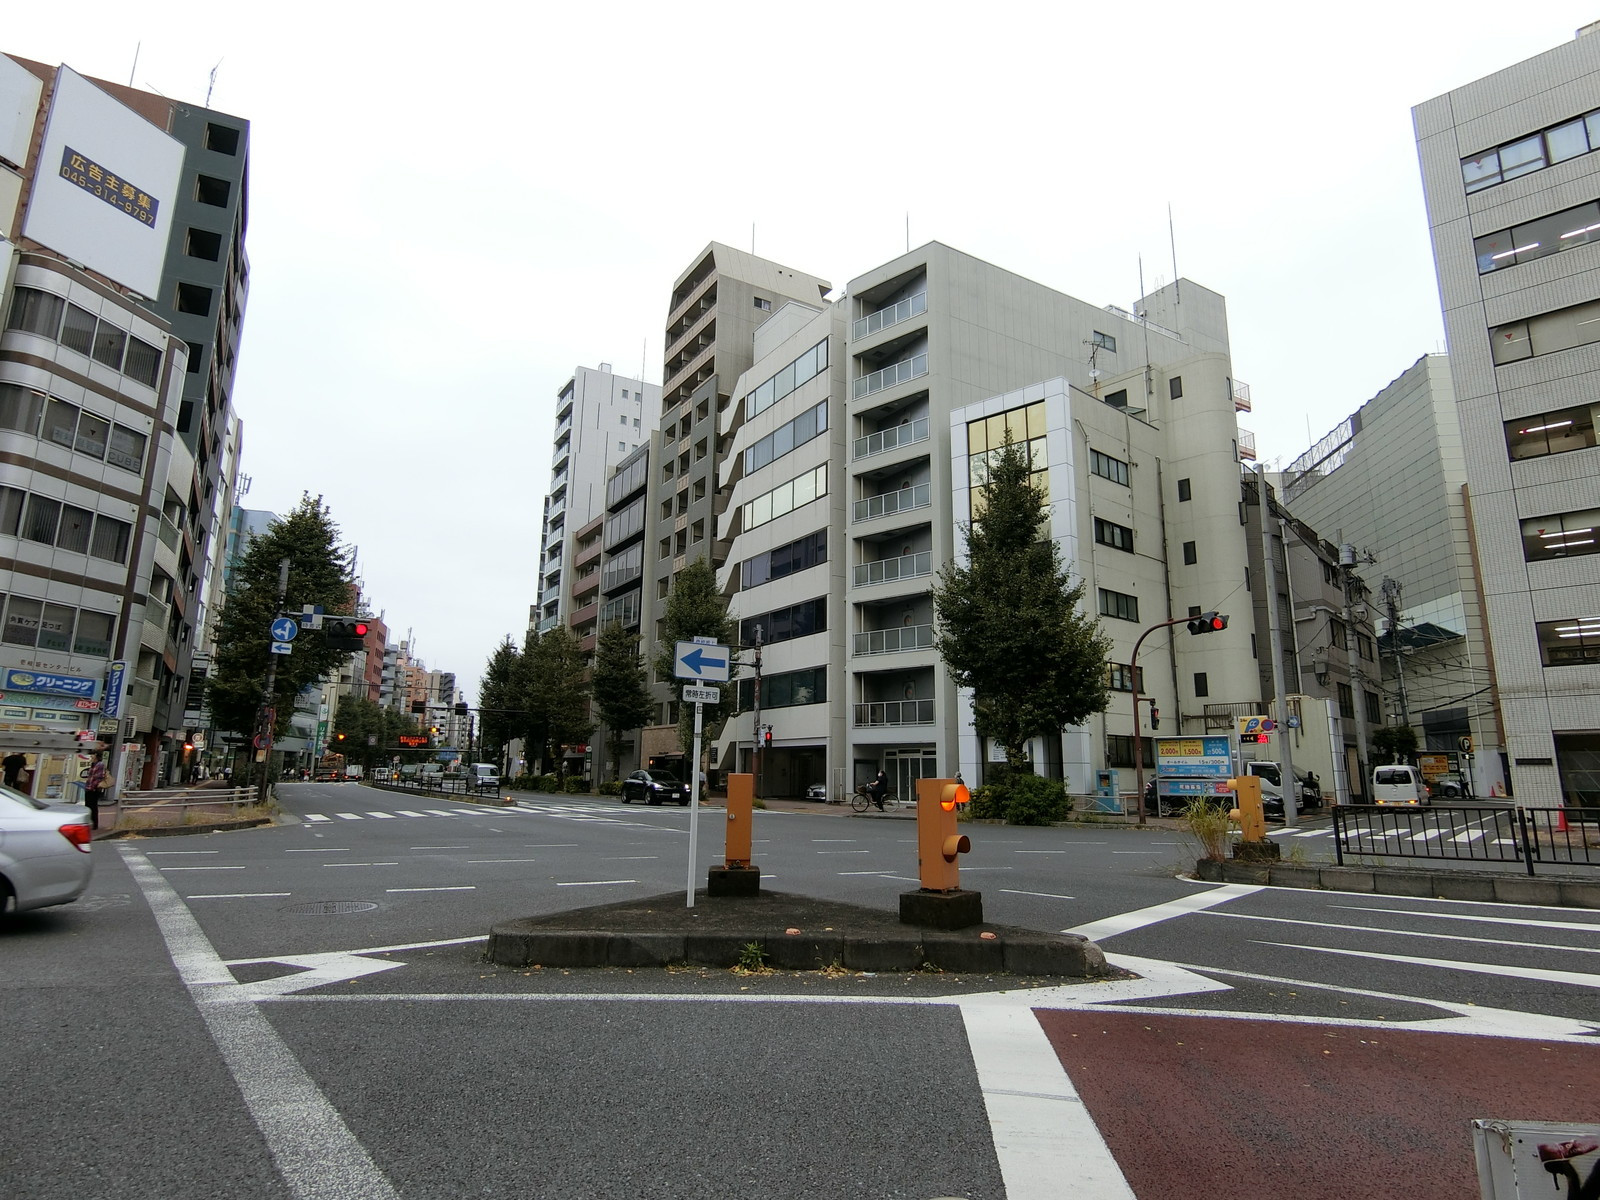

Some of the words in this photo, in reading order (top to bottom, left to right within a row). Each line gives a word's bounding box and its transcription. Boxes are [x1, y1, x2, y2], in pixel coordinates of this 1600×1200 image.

[61, 165, 155, 225] 045-314-9797
[70, 153, 153, 211] 広告主募集
[108, 451, 140, 469] CUBE
[35, 676, 93, 690] クリーニング
[105, 671, 121, 714] クリーニング
[685, 689, 718, 700] 常時左折可
